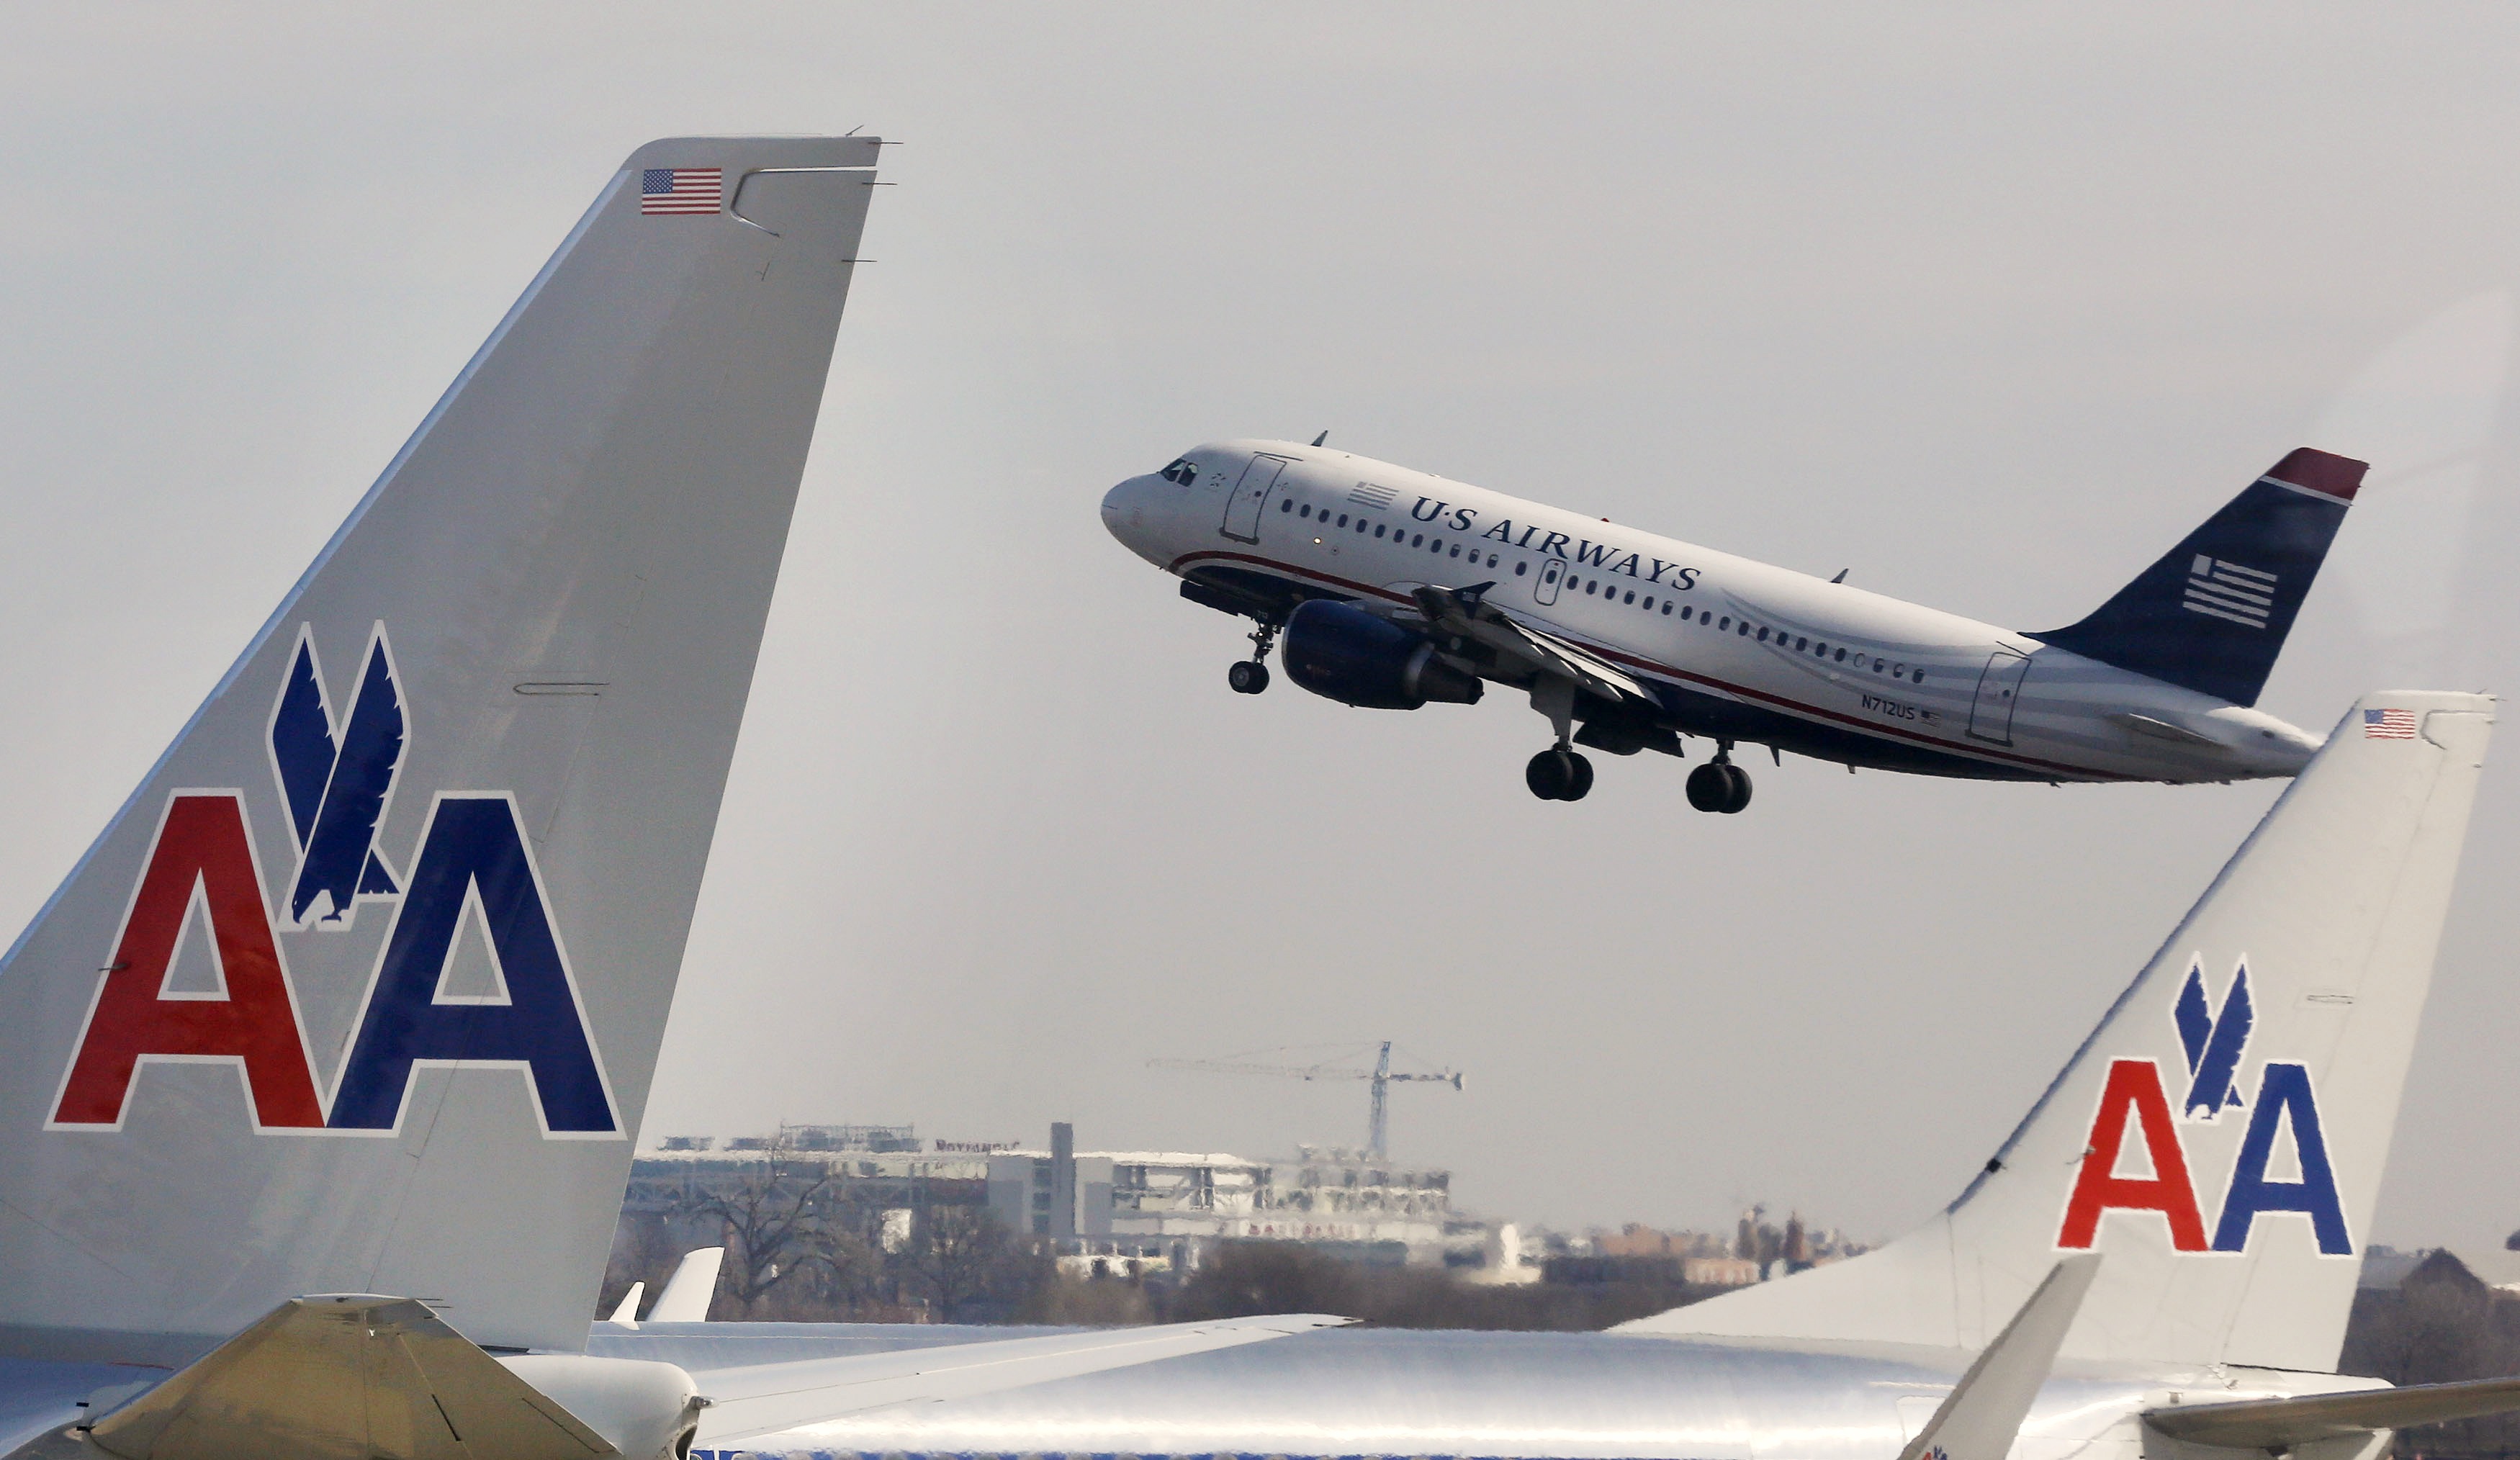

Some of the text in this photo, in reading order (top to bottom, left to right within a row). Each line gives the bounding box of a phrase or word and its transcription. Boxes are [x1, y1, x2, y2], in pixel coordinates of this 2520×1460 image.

[1481, 518, 1701, 591] AIRWAYS
[1862, 694, 1915, 720] N712US
[43, 788, 628, 1140] AA
[2051, 1055, 2358, 1260] AA
